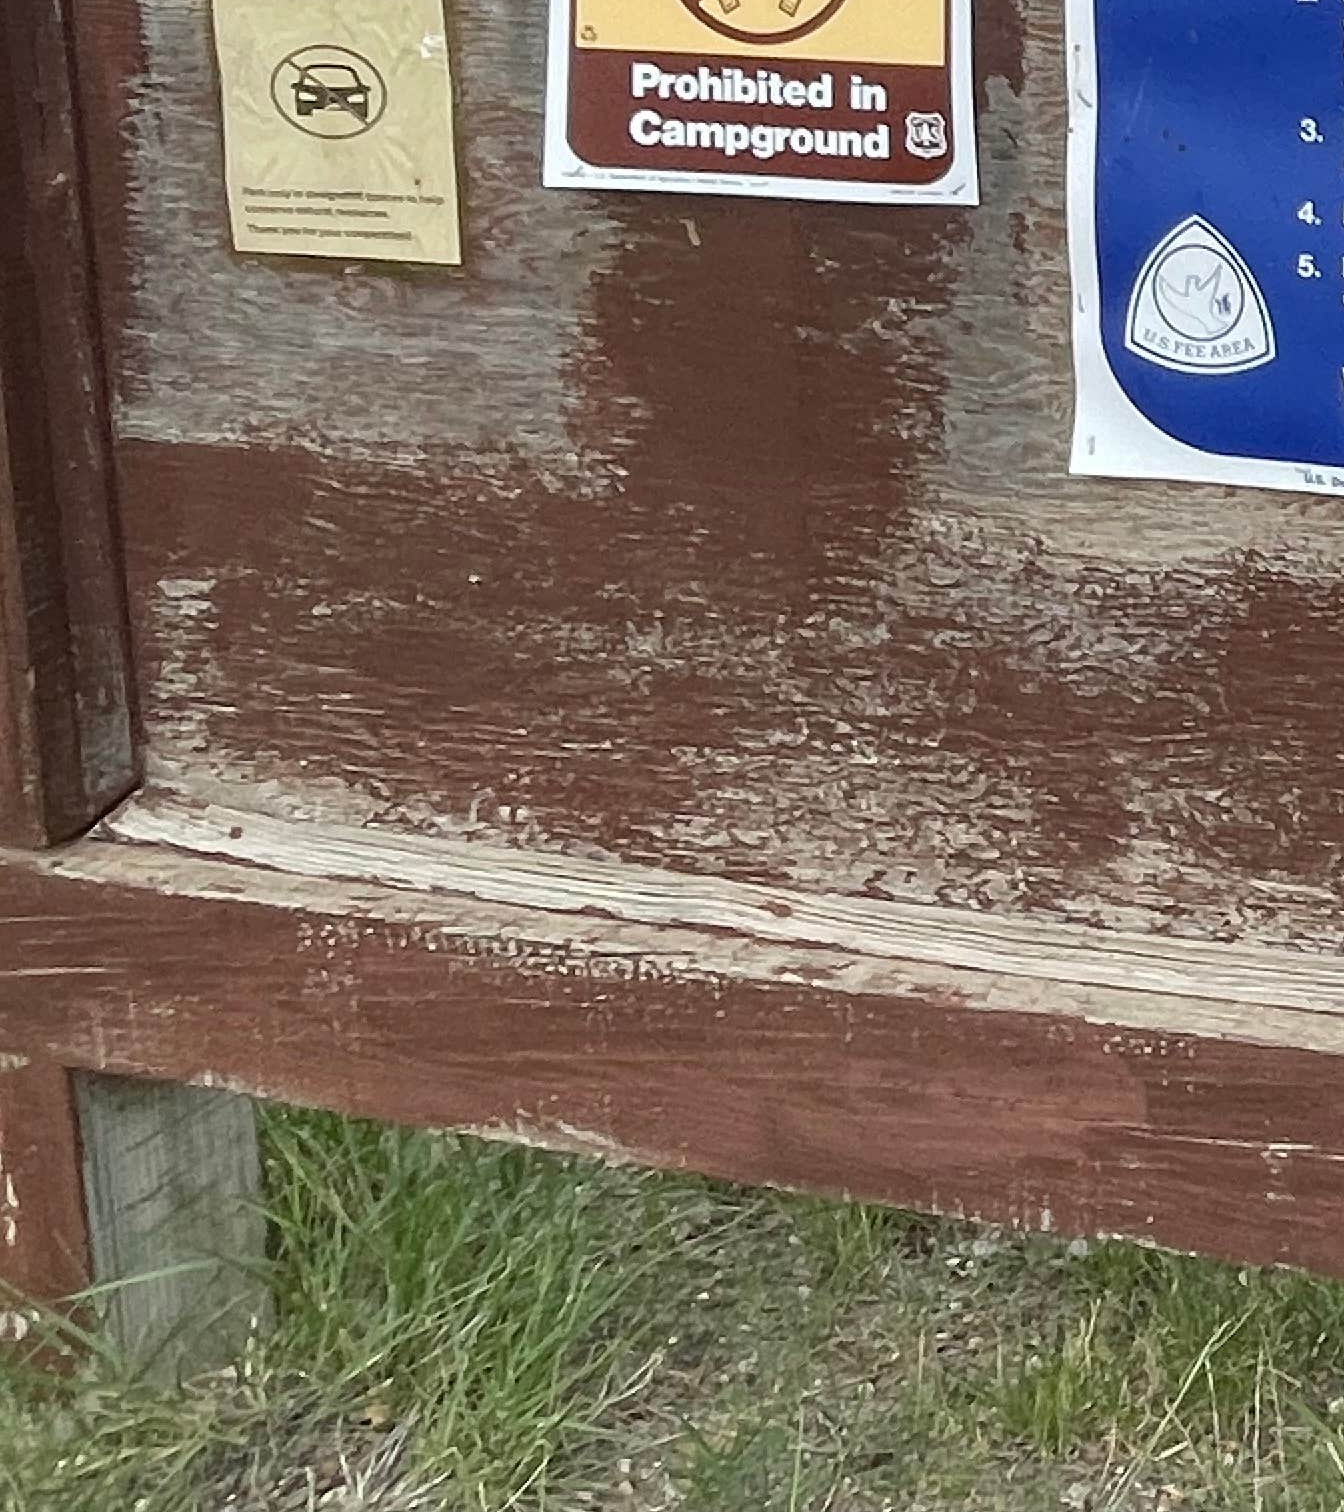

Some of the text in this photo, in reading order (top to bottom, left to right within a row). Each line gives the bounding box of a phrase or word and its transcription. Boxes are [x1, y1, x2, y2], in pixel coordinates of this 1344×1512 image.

[631, 62, 888, 112] Prohibited in
[628, 108, 890, 160] Campground
[1300, 118, 1324, 143] 3.
[1297, 201, 1322, 226] 4.
[1297, 254, 1322, 279] 5.
[1174, 342, 1208, 358] FEE
[1210, 337, 1255, 358] AREA
